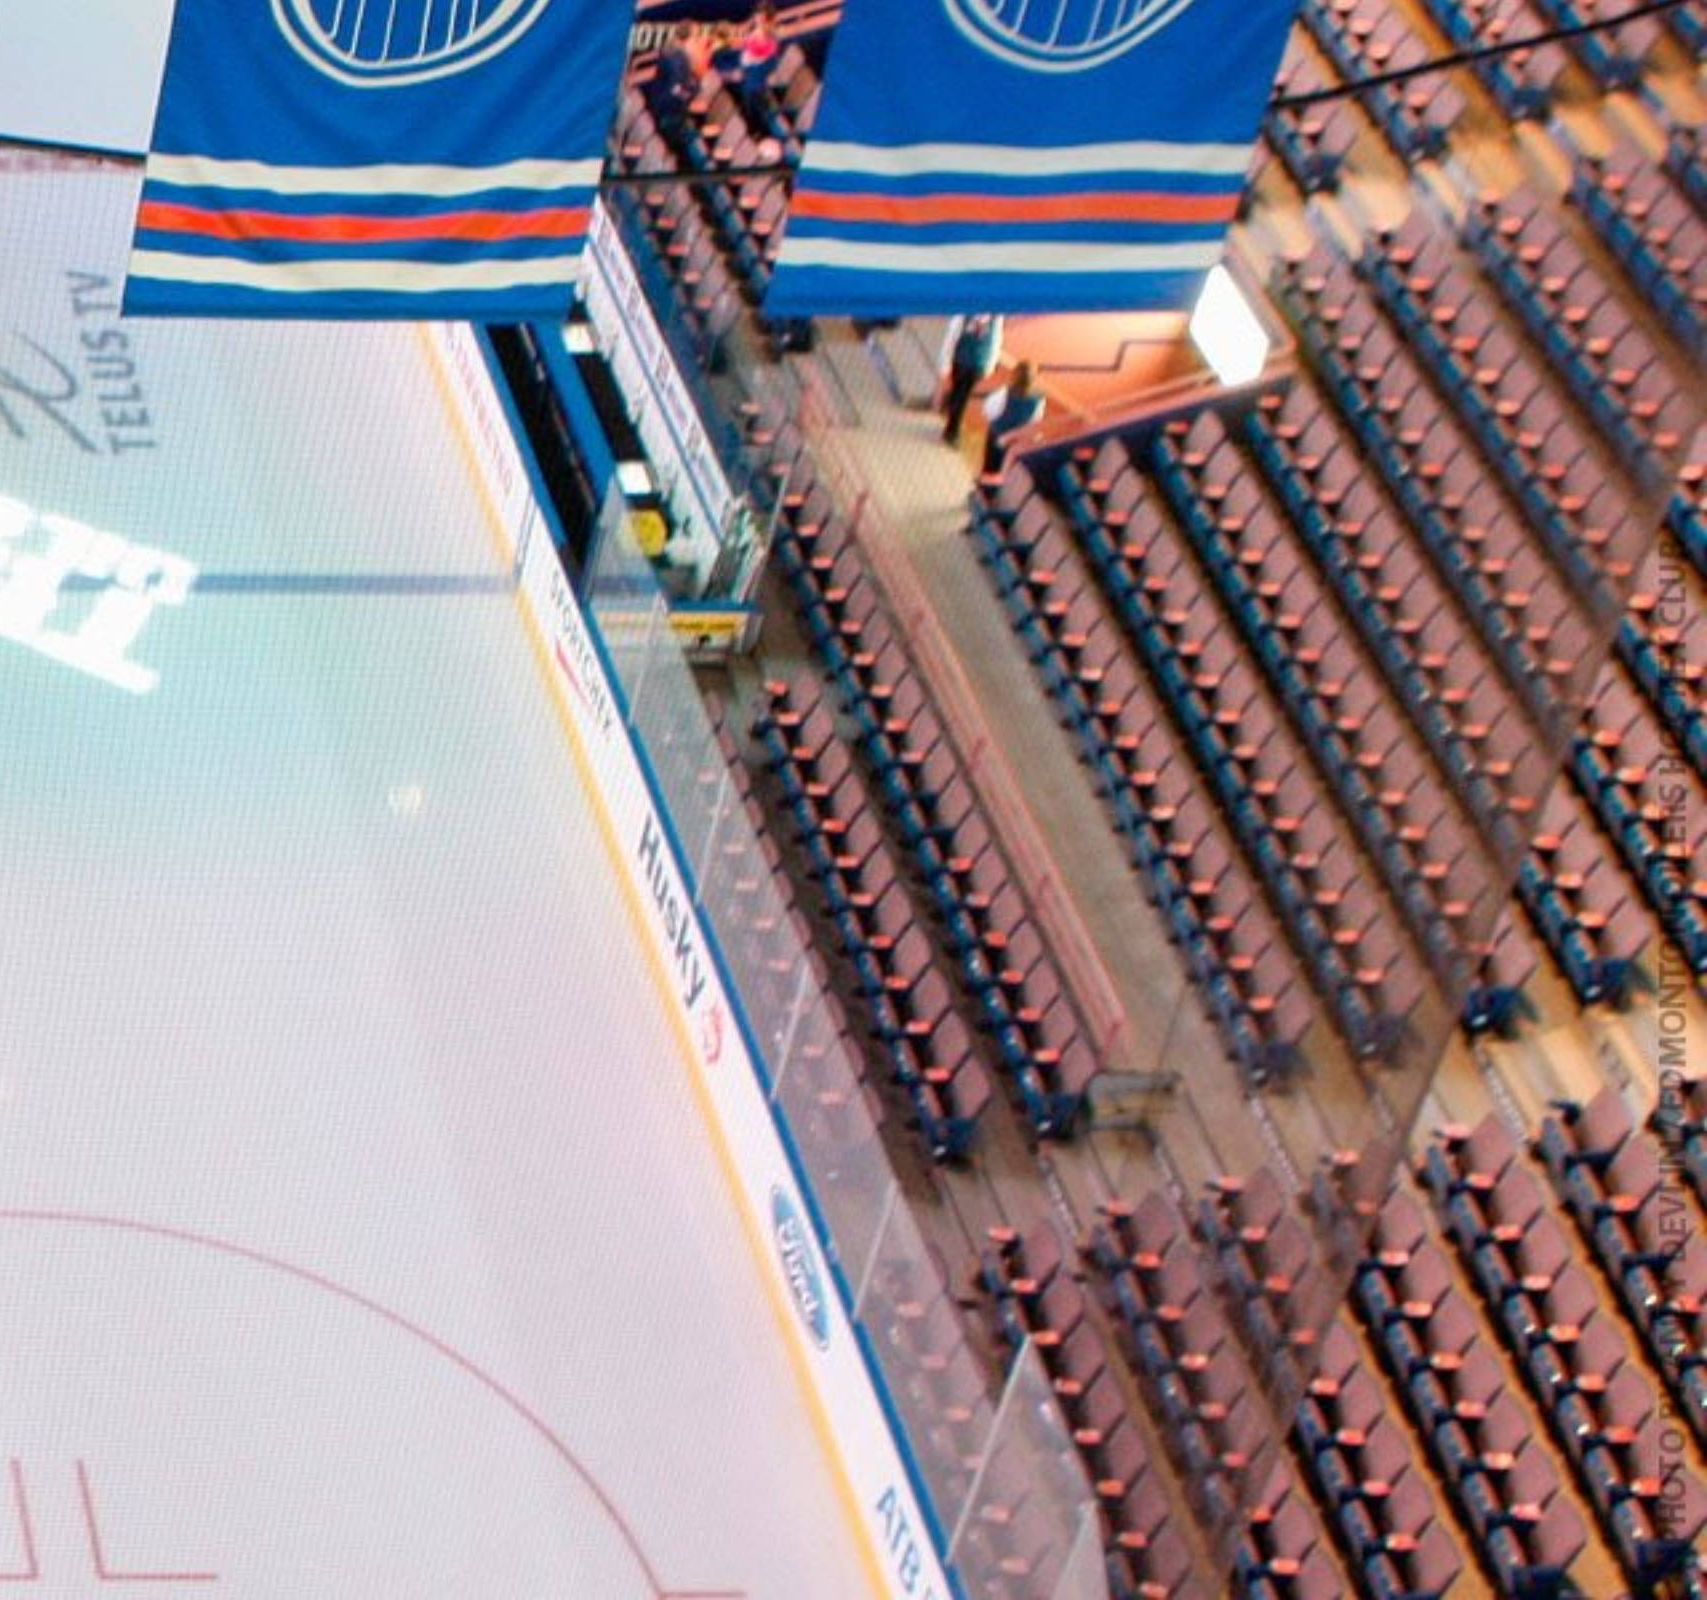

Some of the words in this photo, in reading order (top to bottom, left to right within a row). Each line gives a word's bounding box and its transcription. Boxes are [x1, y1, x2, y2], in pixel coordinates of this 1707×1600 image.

[65, 270, 119, 316] TV
[80, 329, 158, 455] TELUS
[638, 812, 706, 1009] Husky
[875, 1485, 921, 1594] ATB
